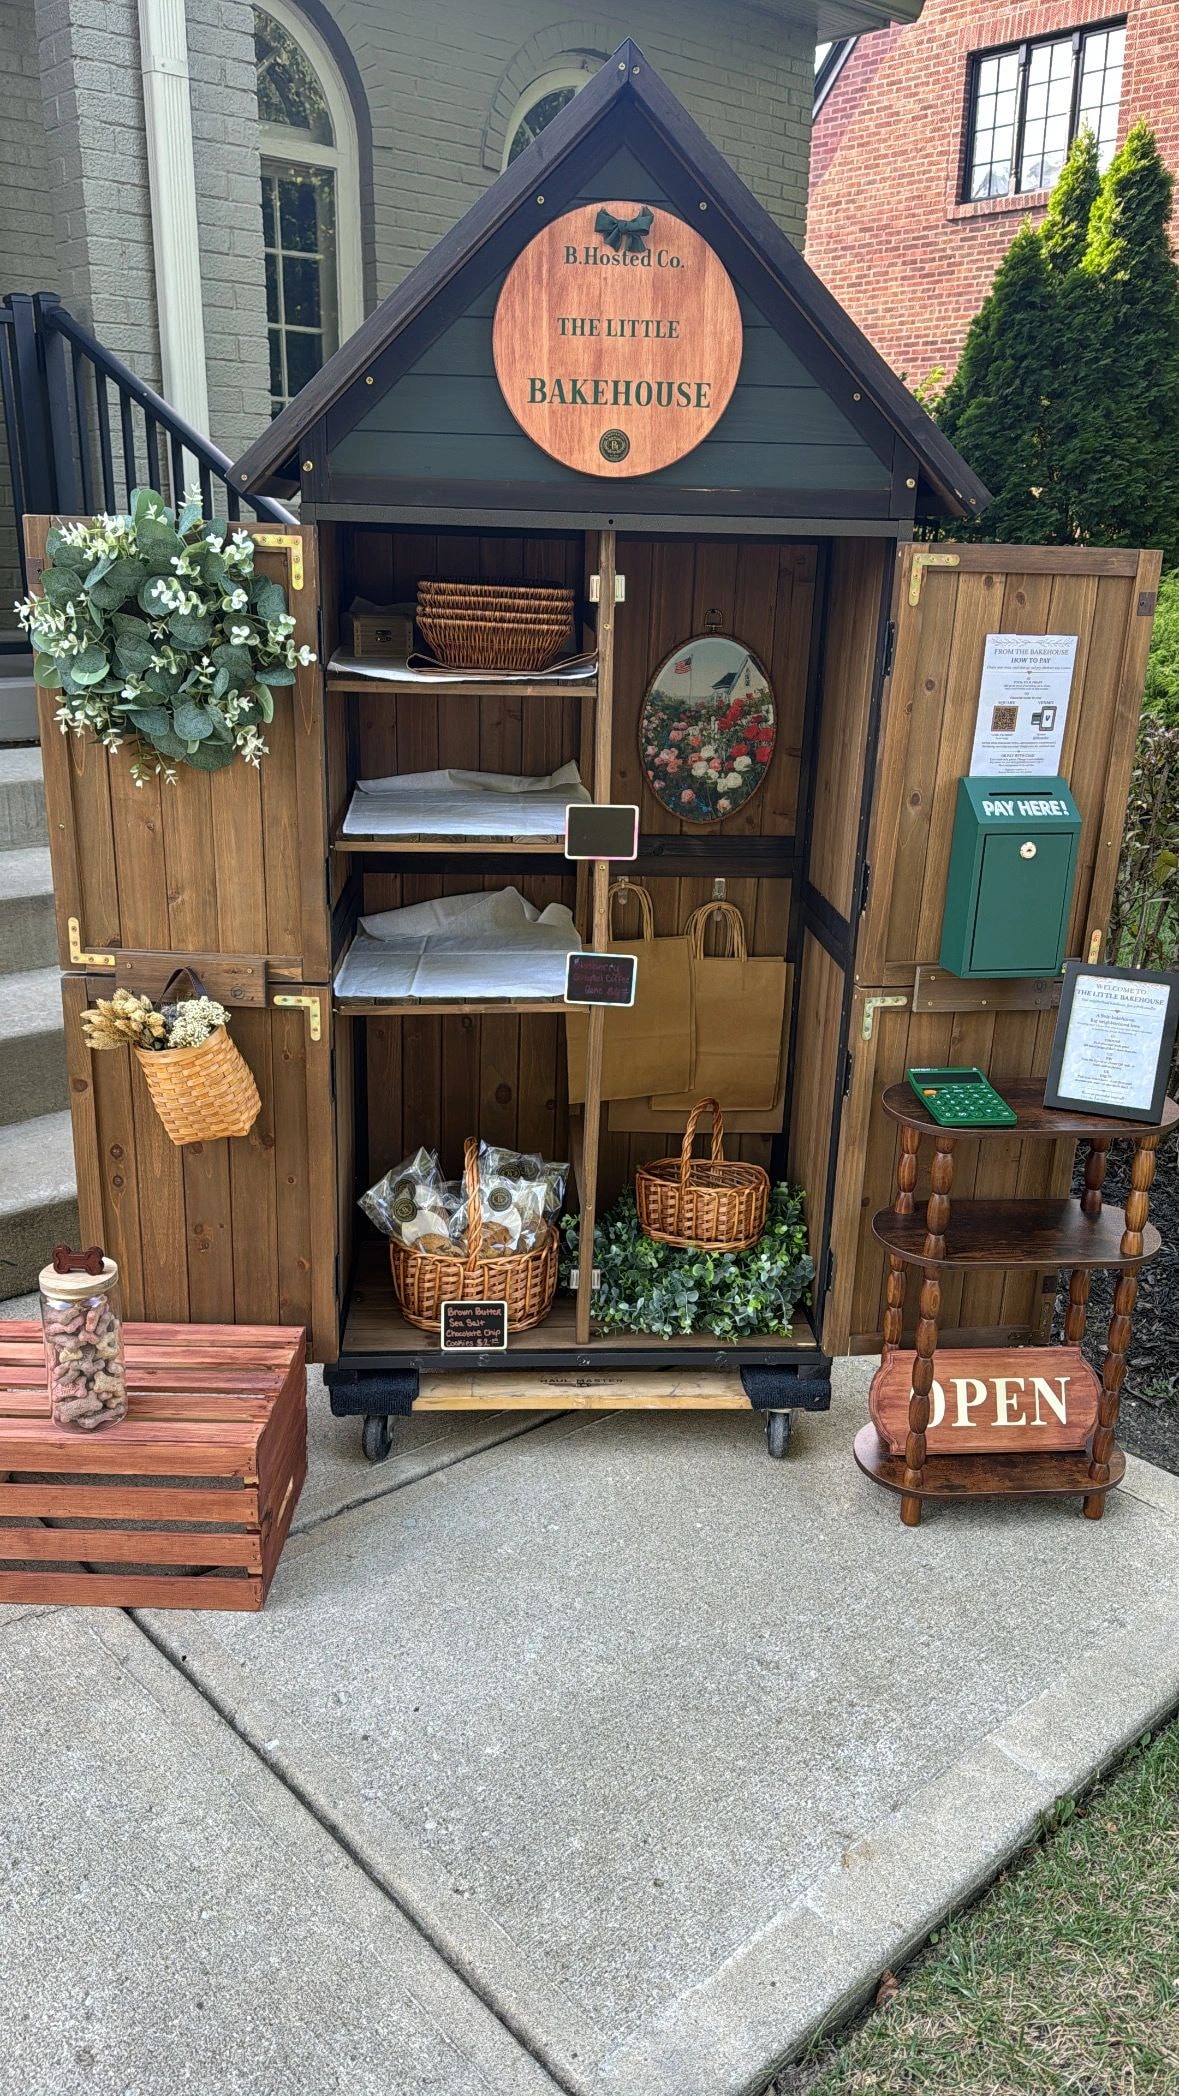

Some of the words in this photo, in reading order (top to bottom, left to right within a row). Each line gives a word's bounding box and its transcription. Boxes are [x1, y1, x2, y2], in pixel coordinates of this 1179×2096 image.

[563, 245, 652, 268] B.Hosted
[656, 248, 685, 269] Co.
[557, 317, 600, 336] THE
[605, 319, 680, 339] LITTLE
[527, 377, 712, 408] BAKEHOUSE
[994, 648, 1014, 656] FROM
[1016, 648, 1029, 656] THE
[1030, 648, 1069, 656] BAKEHOUSE
[981, 800, 1015, 816] PAY
[1016, 800, 1070, 816] HERE!
[1096, 983, 1135, 994] WELCOME
[1136, 988, 1148, 996] TO
[1078, 989, 1092, 997] THE
[1092, 991, 1119, 1000] LITTLE
[1119, 993, 1165, 1006] BAKEHOUSE
[447, 1307, 473, 1317] Brown
[449, 1318, 464, 1327] Sea
[466, 1318, 486, 1327] Salt
[446, 1329, 482, 1338] Chocolate
[483, 1329, 501, 1338] Chip
[446, 1339, 473, 1347] Cookies
